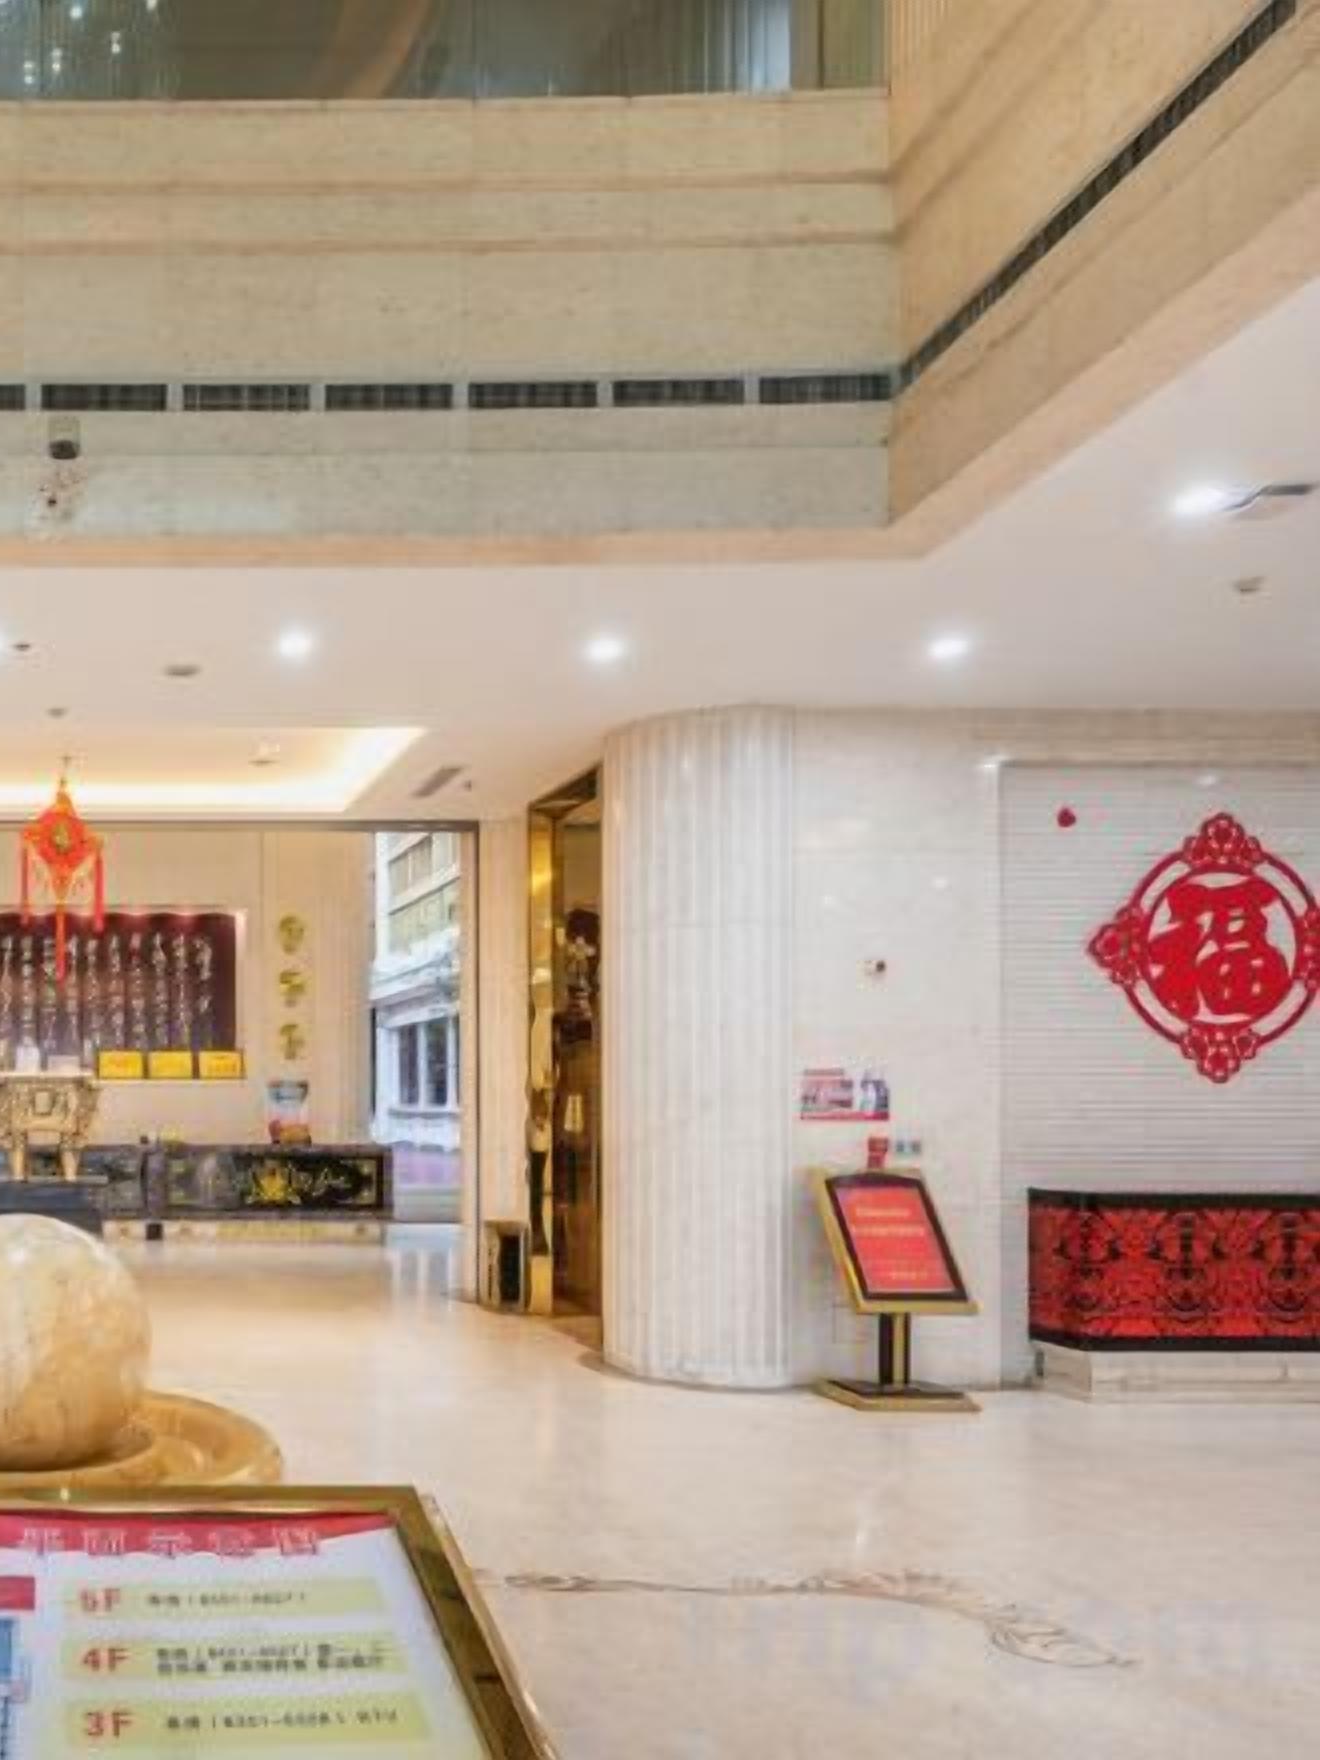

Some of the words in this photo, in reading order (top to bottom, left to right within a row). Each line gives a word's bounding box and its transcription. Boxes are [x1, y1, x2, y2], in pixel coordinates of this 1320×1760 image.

[1148, 875, 1291, 1024] 福
[82, 1648, 130, 1672] 4F
[85, 1711, 133, 1737] 3F
